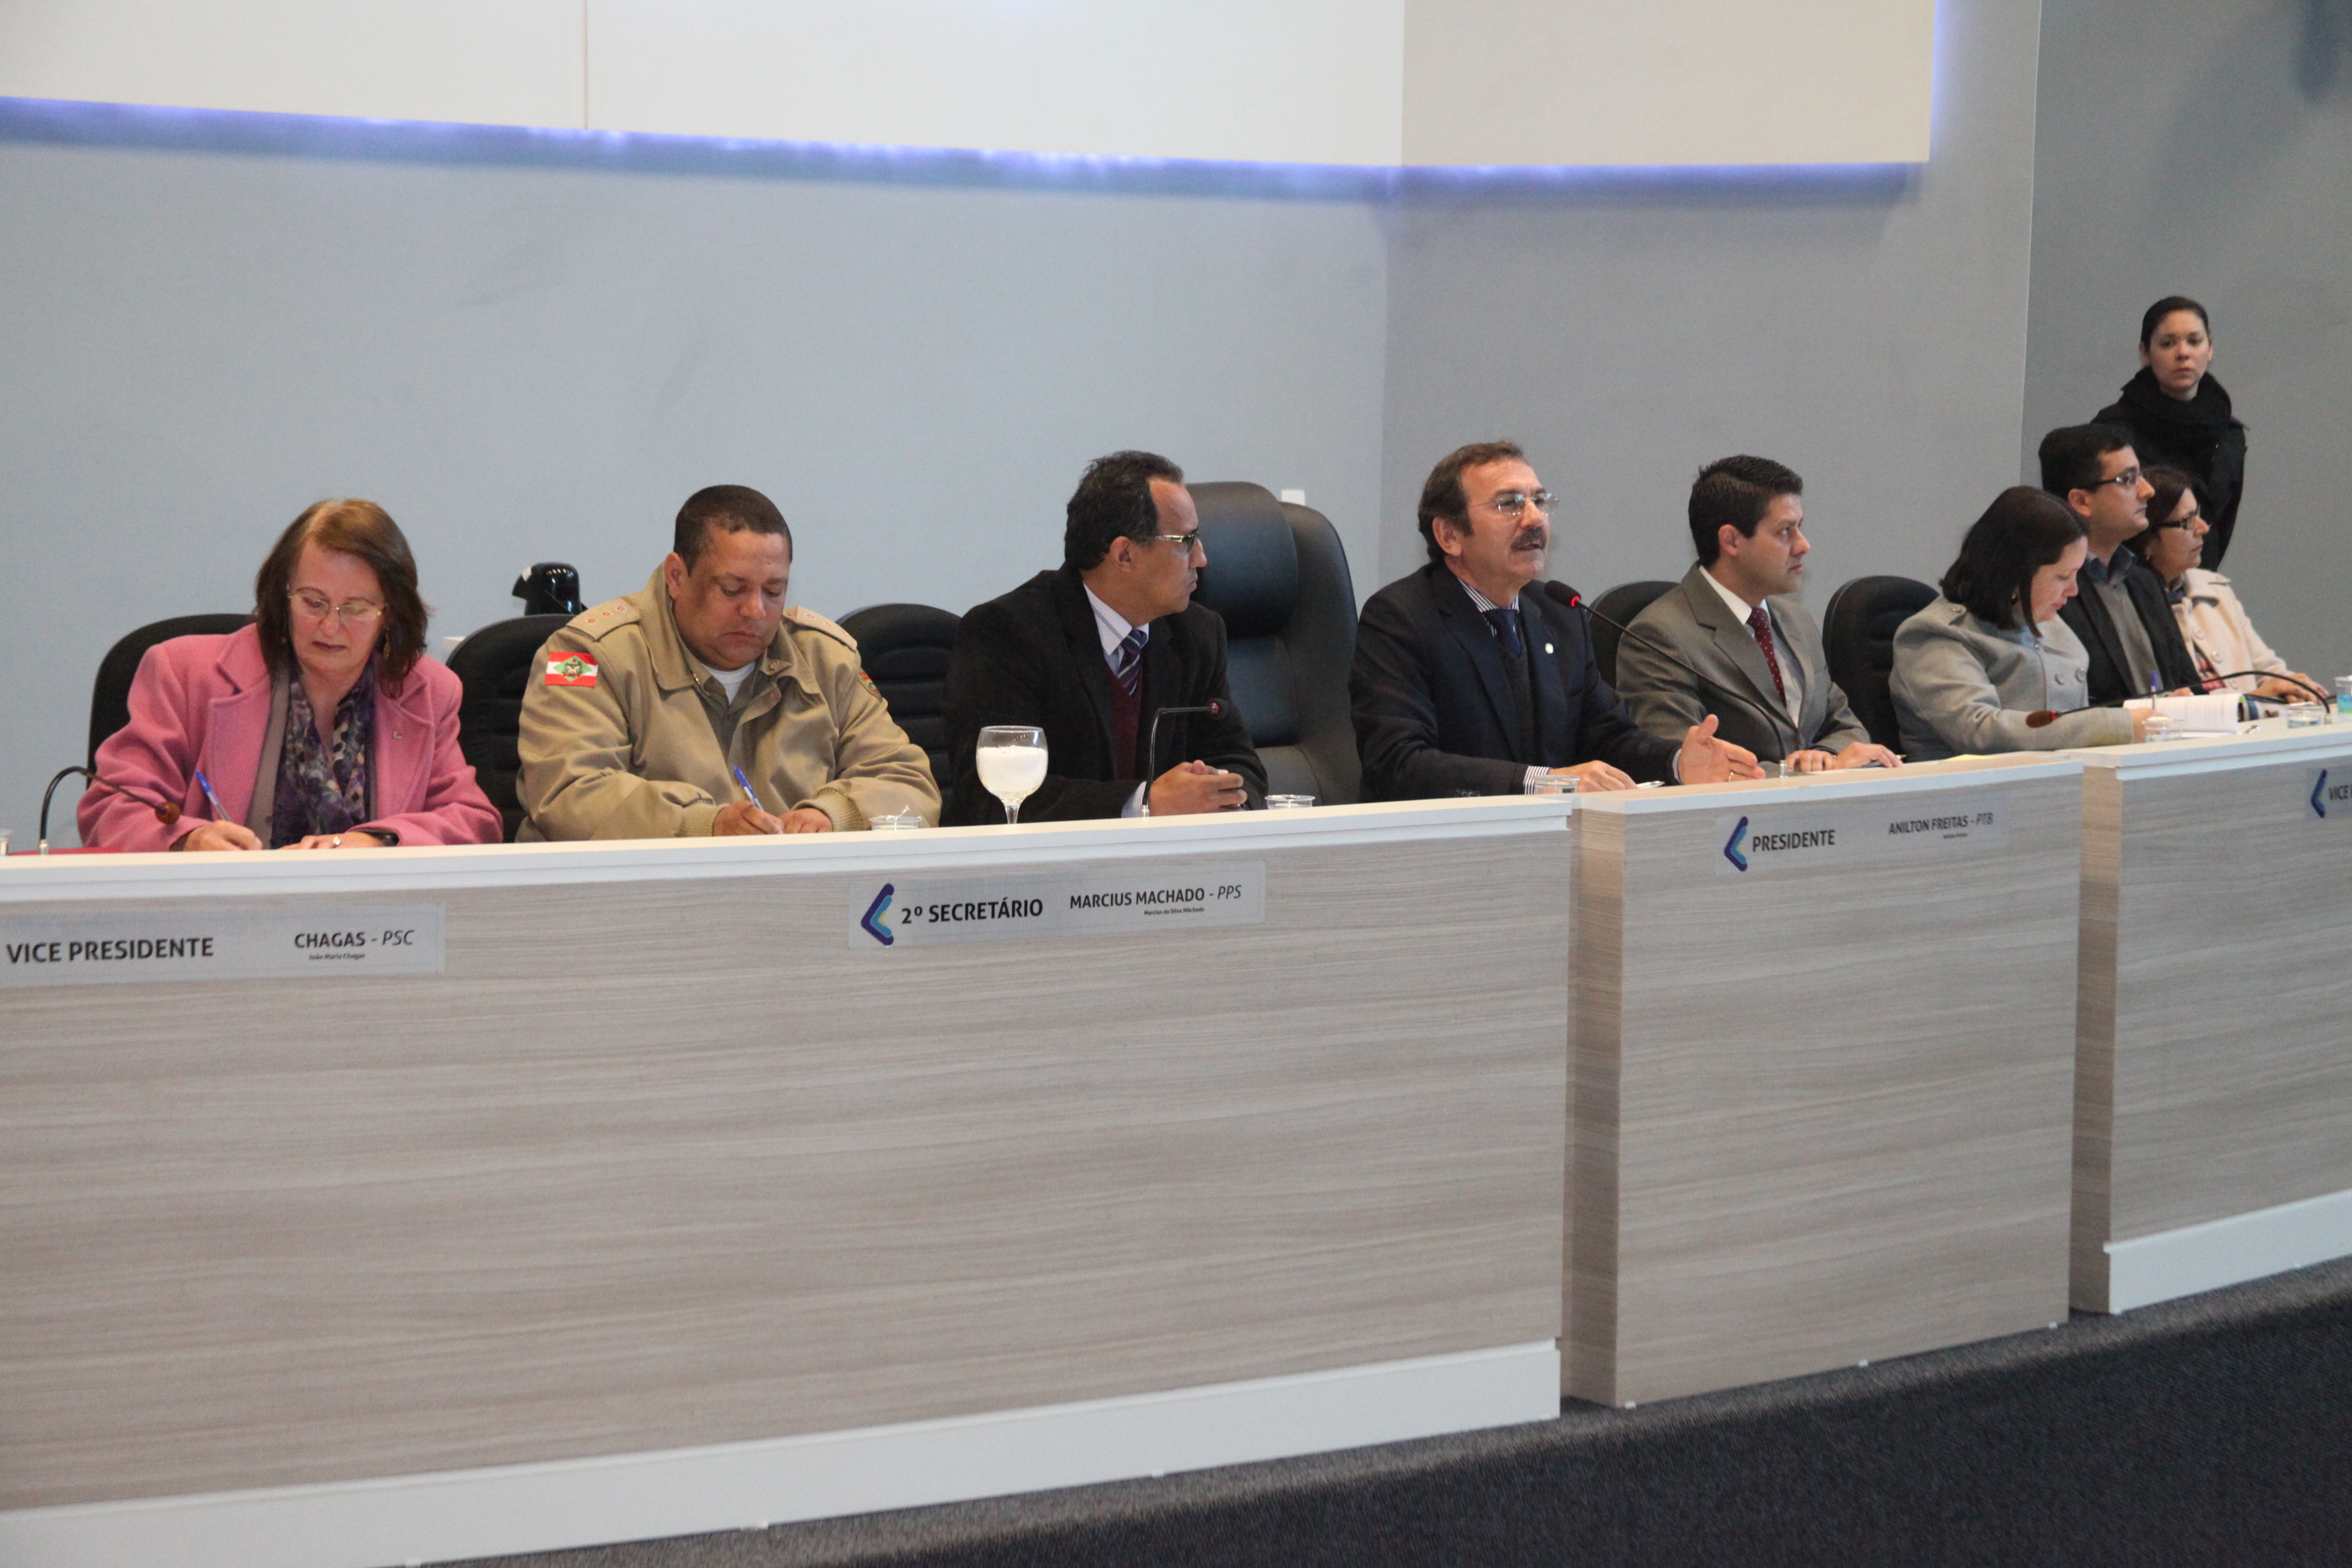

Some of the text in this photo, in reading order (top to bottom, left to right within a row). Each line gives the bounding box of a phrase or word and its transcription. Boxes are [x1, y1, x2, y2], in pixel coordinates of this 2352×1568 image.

[2328, 785, 2349, 800] VICE
[1888, 819, 1930, 835] ANILTON
[1931, 816, 1968, 831] FREITAS
[1752, 830, 1836, 852] PRESIDENTE
[1070, 892, 1132, 909] MARCIUS
[1135, 888, 1205, 905] MACHADO
[1217, 884, 1243, 900] PPS
[928, 896, 1044, 923] SECRETÁRIO
[7, 937, 214, 963] VICE PRESIDENTE
[294, 931, 367, 949] CHAGAS
[382, 929, 415, 946] PSC
